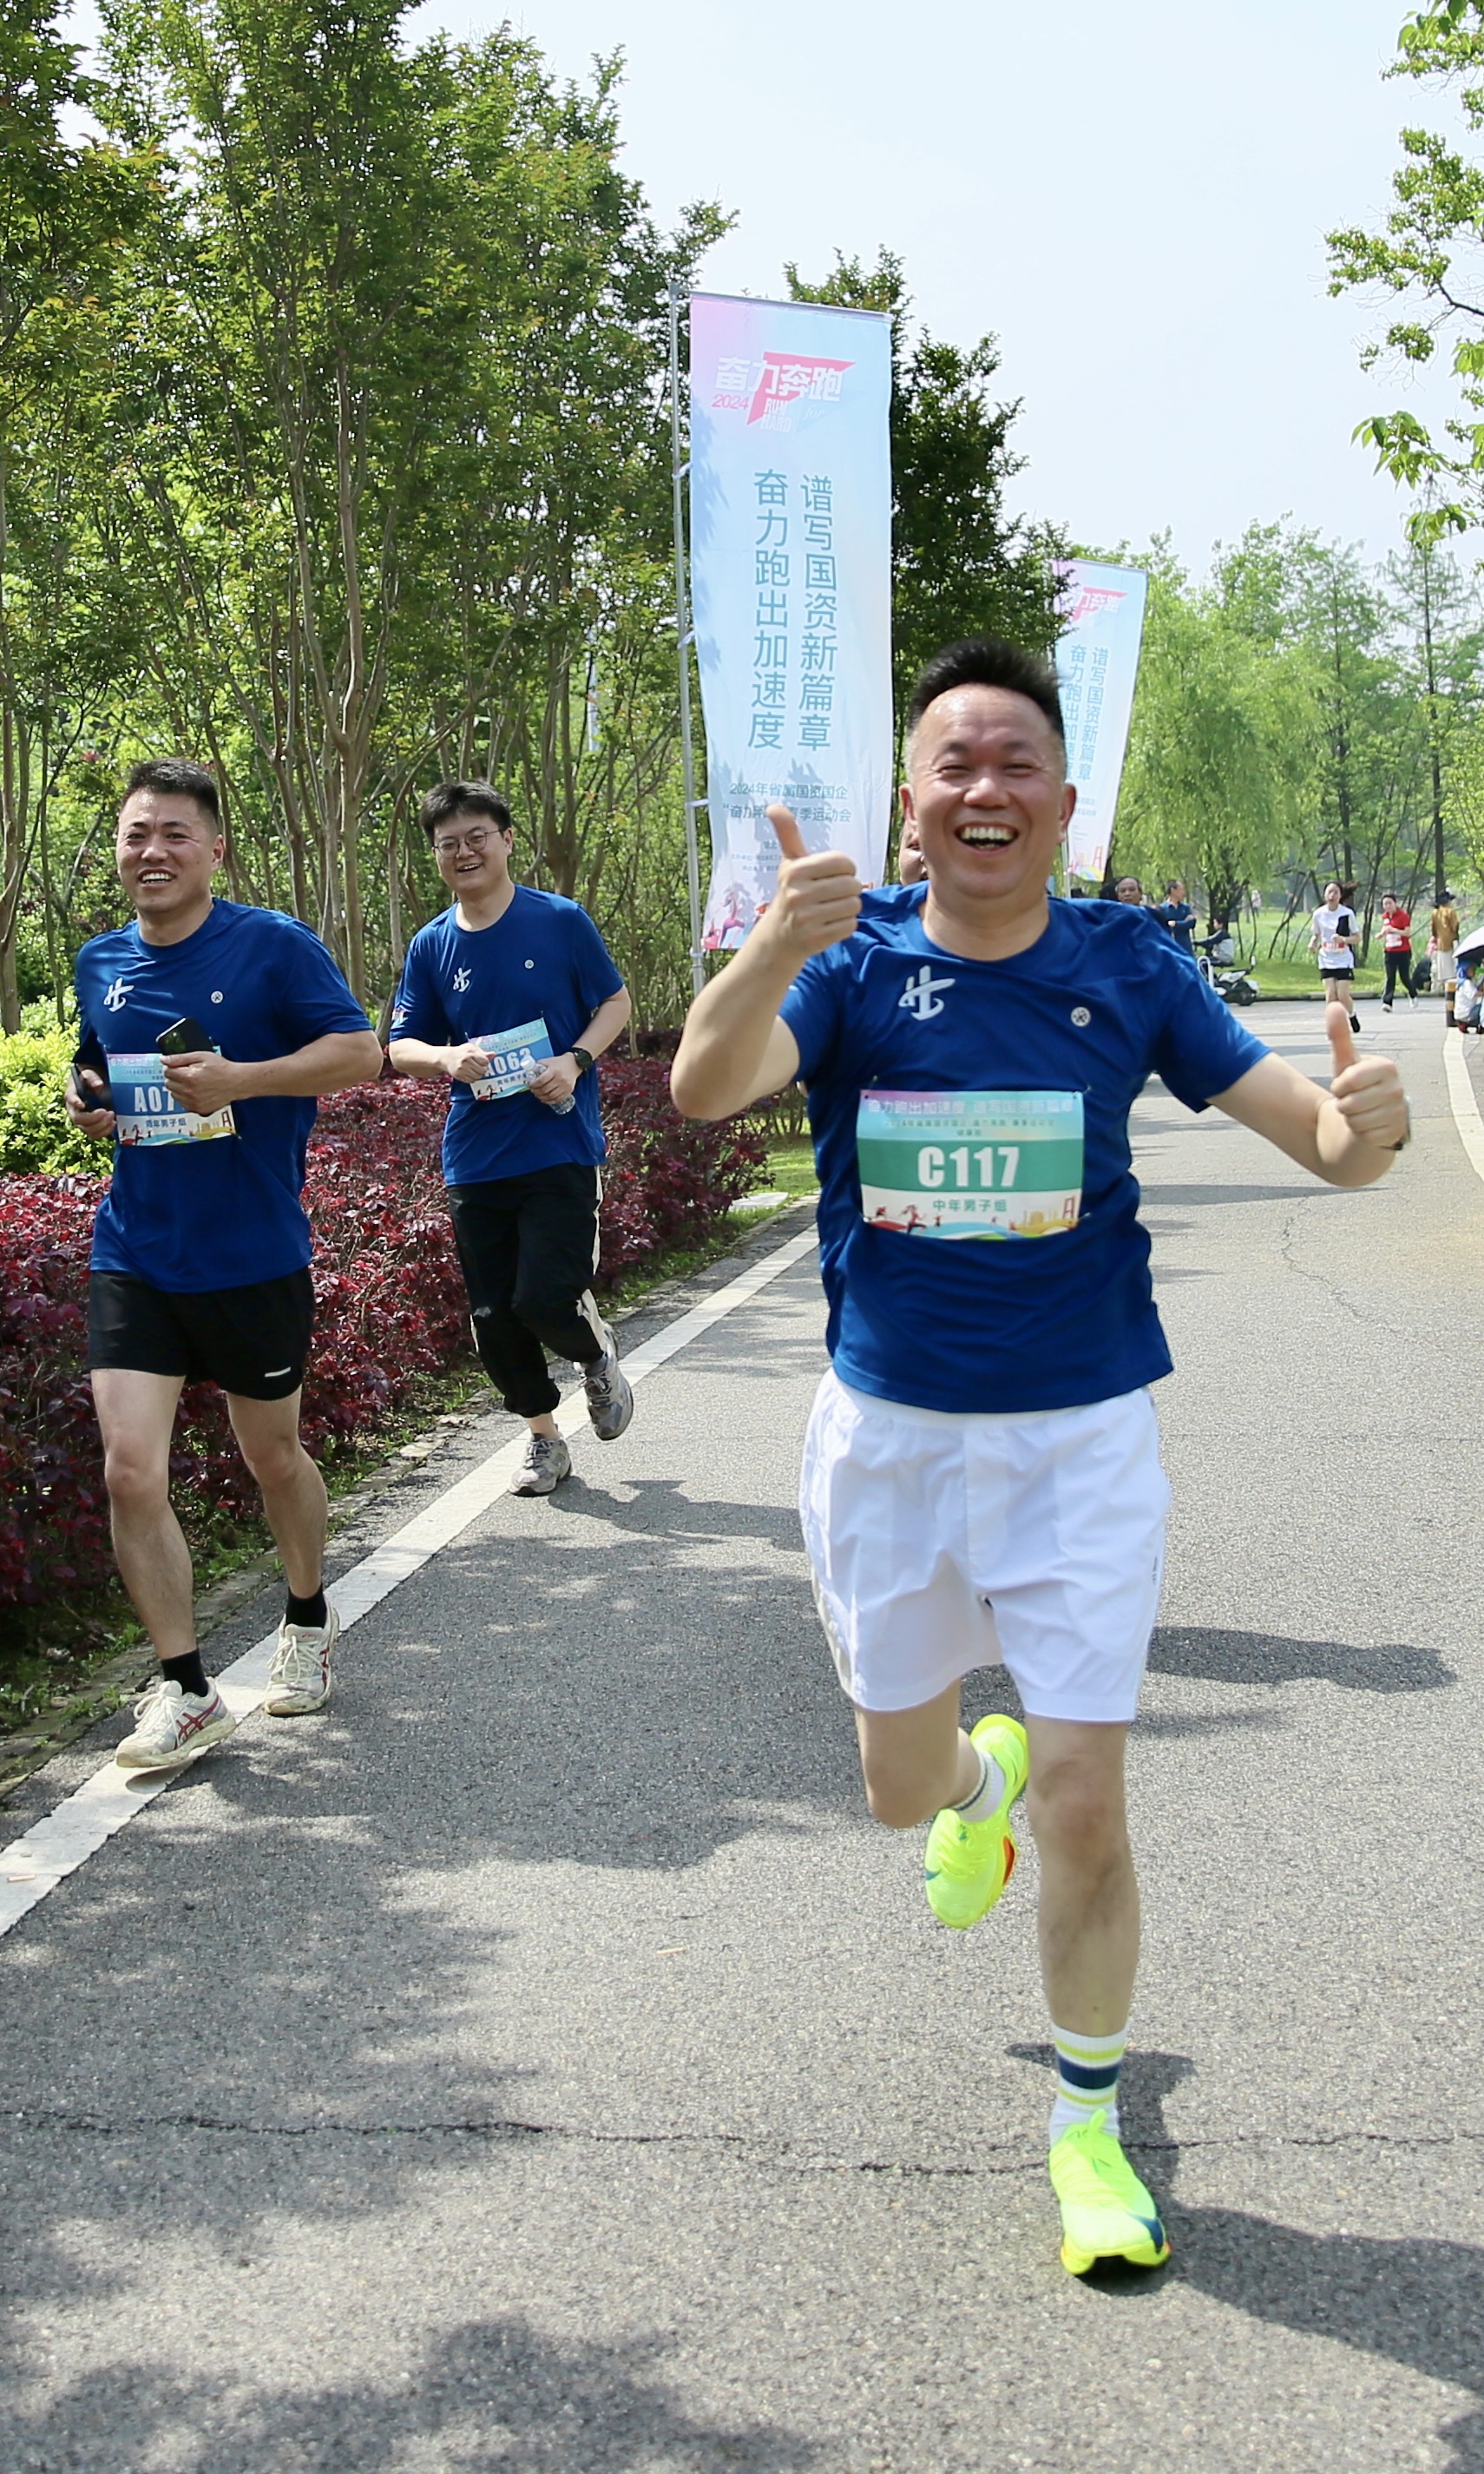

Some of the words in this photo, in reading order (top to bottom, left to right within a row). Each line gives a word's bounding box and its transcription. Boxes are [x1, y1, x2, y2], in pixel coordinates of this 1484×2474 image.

[711, 393, 751, 410] 2024
[714, 356, 844, 403] 奋力奔跑
[747, 468, 791, 751] 奋力跑出加速度
[797, 473, 839, 753] 谱写国资新篇章
[1077, 646, 1109, 781] 谱写国资新篇章
[729, 782, 849, 800] 2024年省属国资国企
[917, 1145, 1020, 1188] C117
[933, 1199, 1007, 1213] 中年男子组
